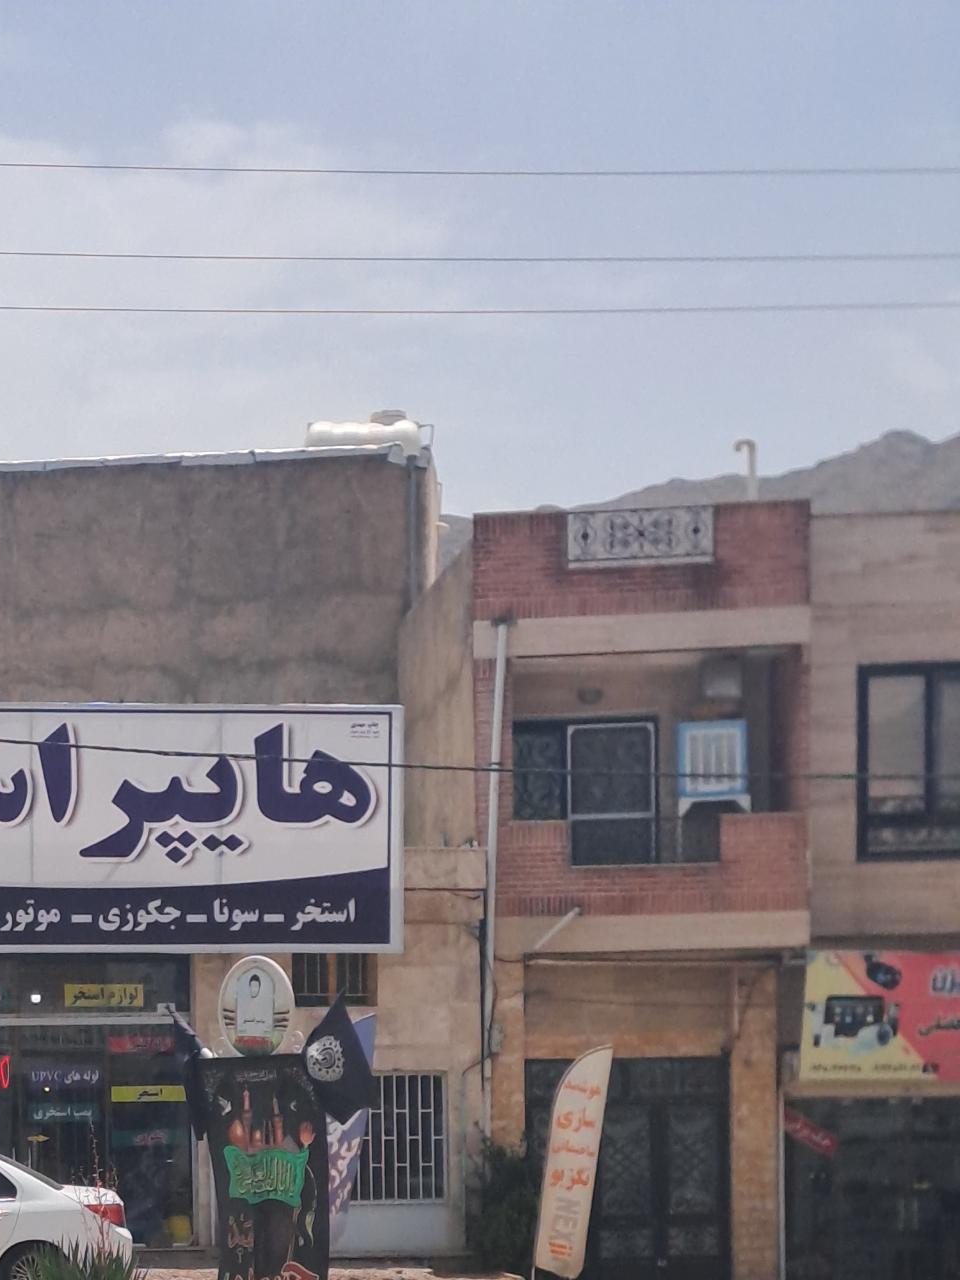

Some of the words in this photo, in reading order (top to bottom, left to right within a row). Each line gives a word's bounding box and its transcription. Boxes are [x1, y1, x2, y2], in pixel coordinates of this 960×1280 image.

[79, 722, 370, 863] هایپر
[0, 900, 61, 931] موتور
[98, 899, 182, 931] جکوزی
[213, 898, 260, 931] سونا
[290, 898, 356, 931] استخر
[31, 1070, 62, 1082] UPVC
